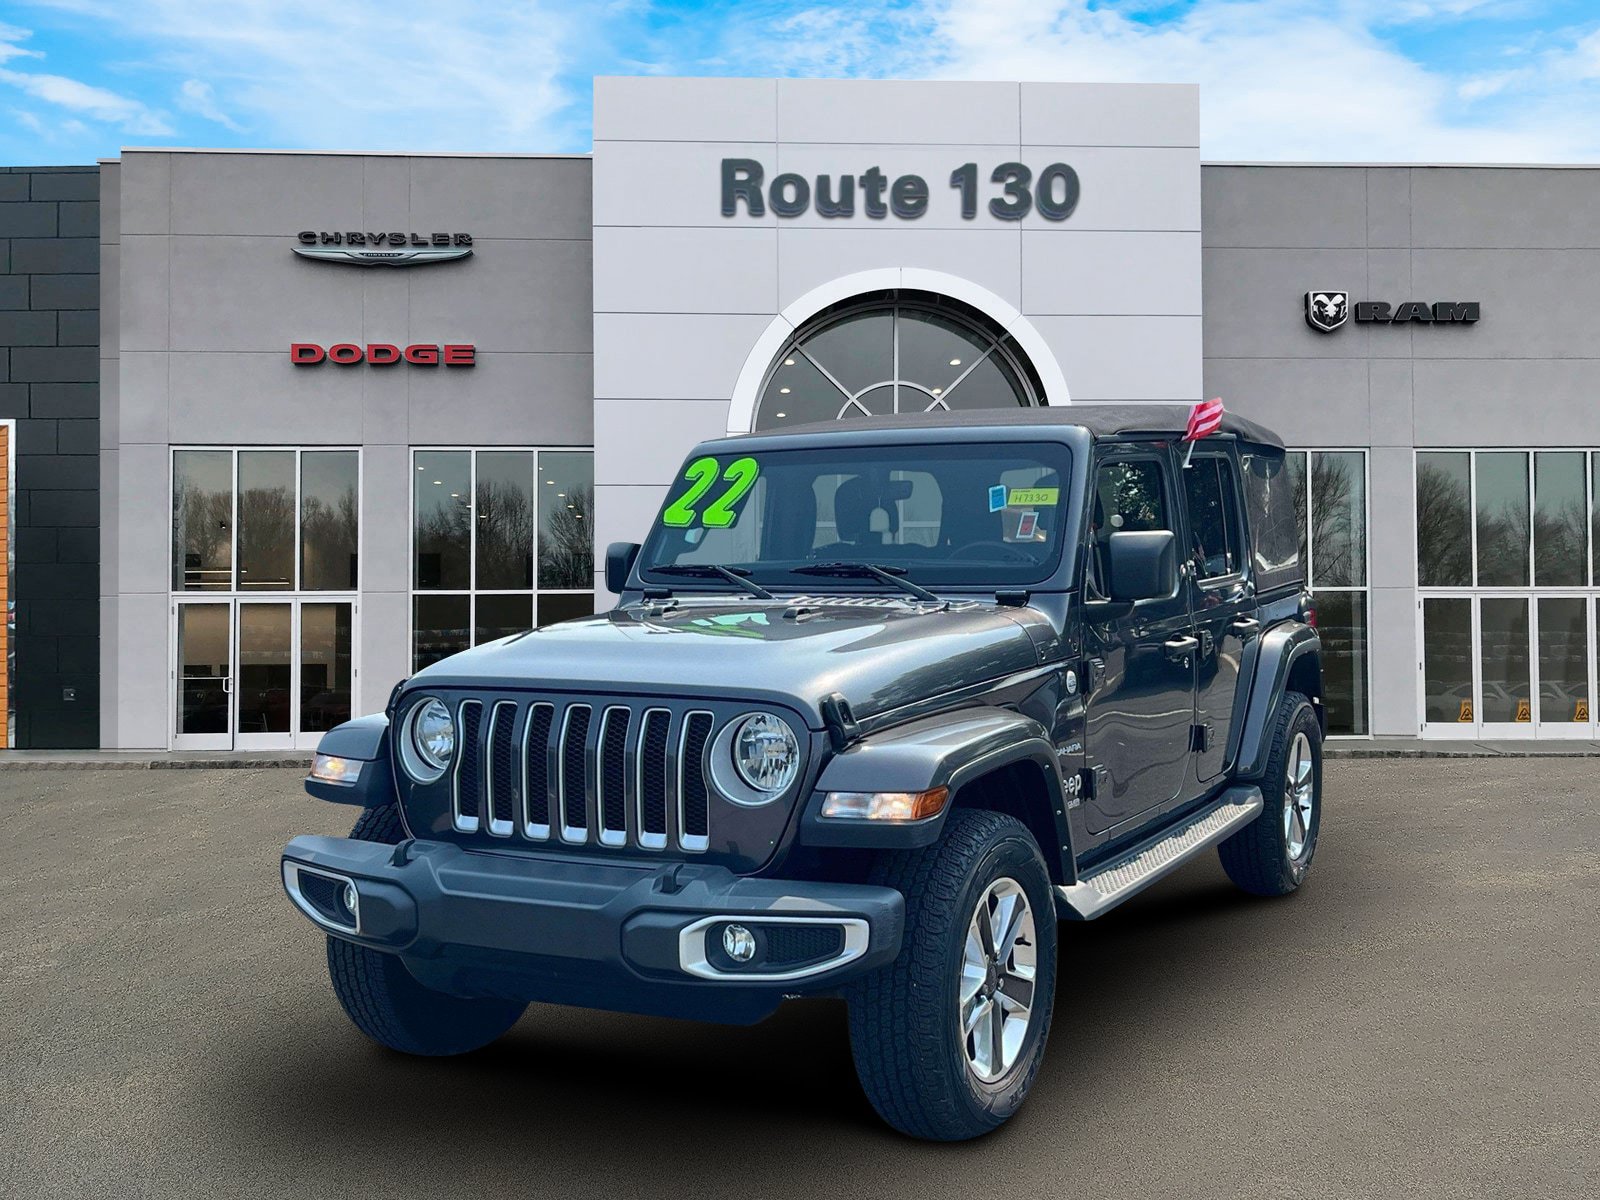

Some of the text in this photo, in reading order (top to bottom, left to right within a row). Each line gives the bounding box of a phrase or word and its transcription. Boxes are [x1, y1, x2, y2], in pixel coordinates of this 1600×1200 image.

[720, 158, 1081, 221] Route 130
[298, 231, 473, 246] CHRYSLER
[1355, 302, 1480, 324] RAM
[291, 343, 475, 366] DODGE
[663, 457, 759, 528] 22
